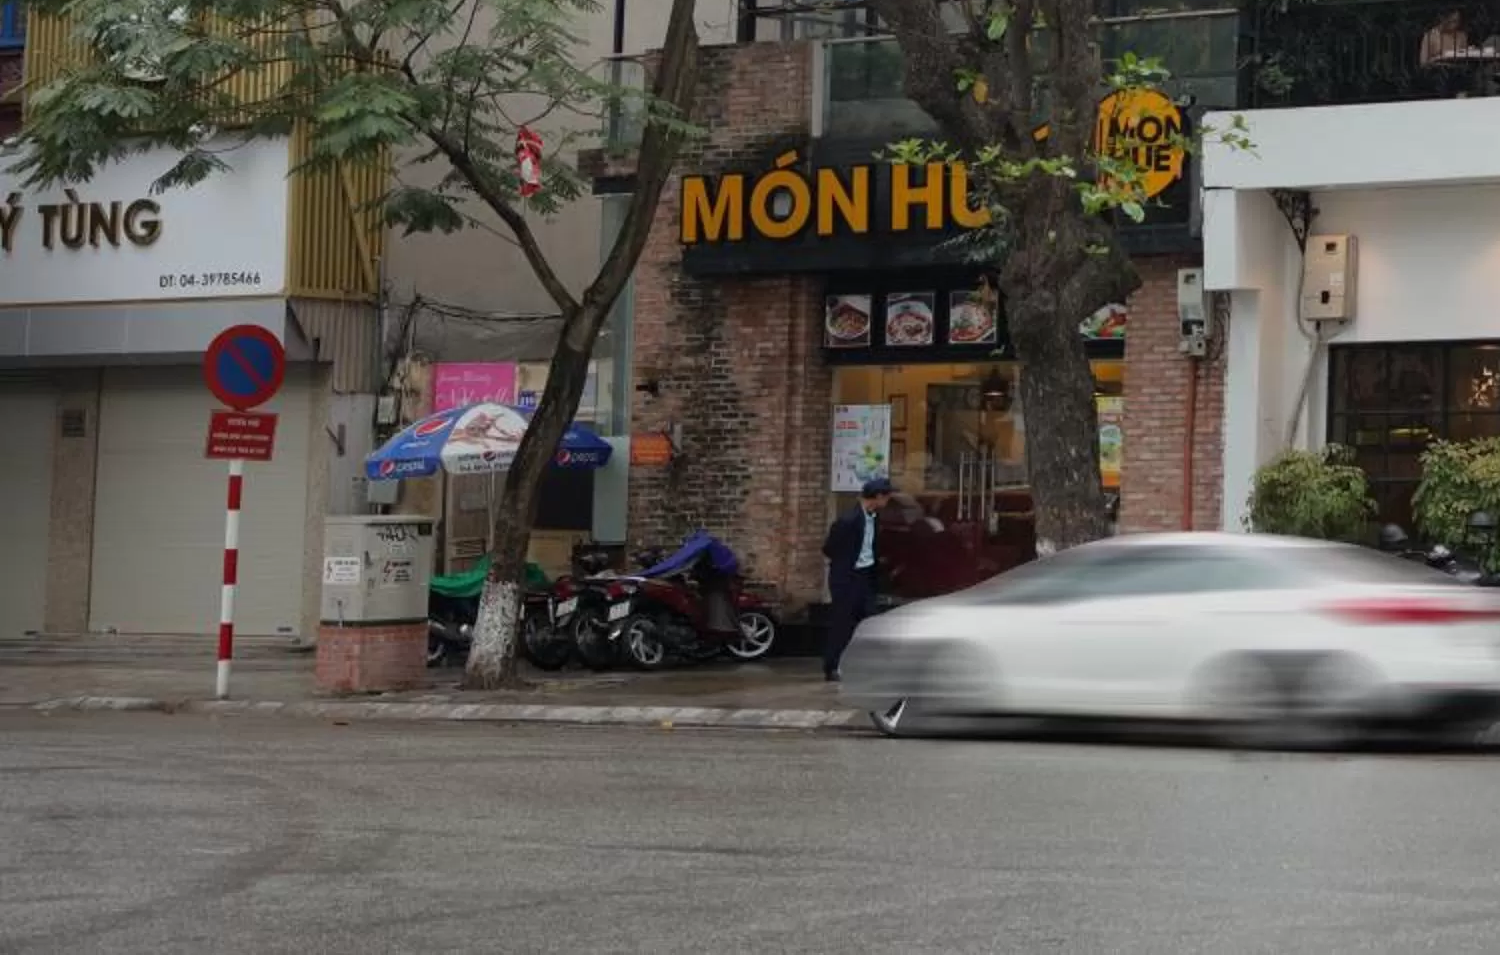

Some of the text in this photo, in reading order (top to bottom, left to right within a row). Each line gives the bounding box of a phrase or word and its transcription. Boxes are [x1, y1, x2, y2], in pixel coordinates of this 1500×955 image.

[38, 188, 162, 250] TÙNG
[680, 149, 870, 243] MÓN
[180, 272, 261, 287] 04-39785466
